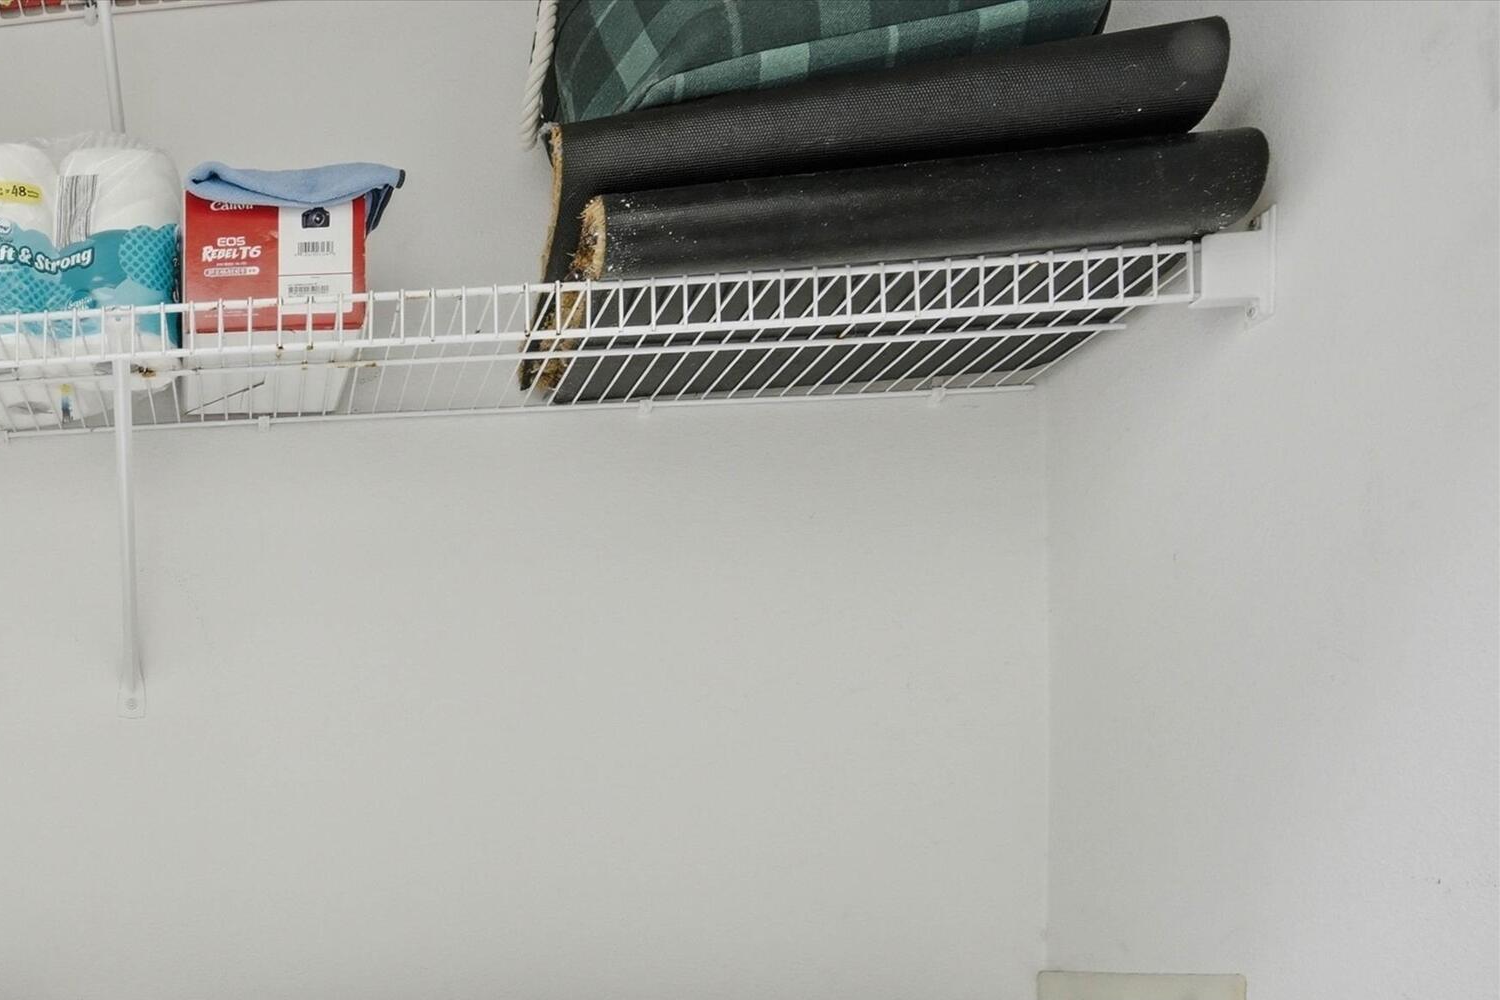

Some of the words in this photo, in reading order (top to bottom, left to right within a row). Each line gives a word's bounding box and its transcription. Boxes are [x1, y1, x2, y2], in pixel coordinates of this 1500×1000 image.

[11, 184, 27, 197] 48
[217, 236, 246, 247] EOS
[19, 246, 33, 265] &
[34, 247, 93, 273] Strong
[239, 245, 262, 260] T6
